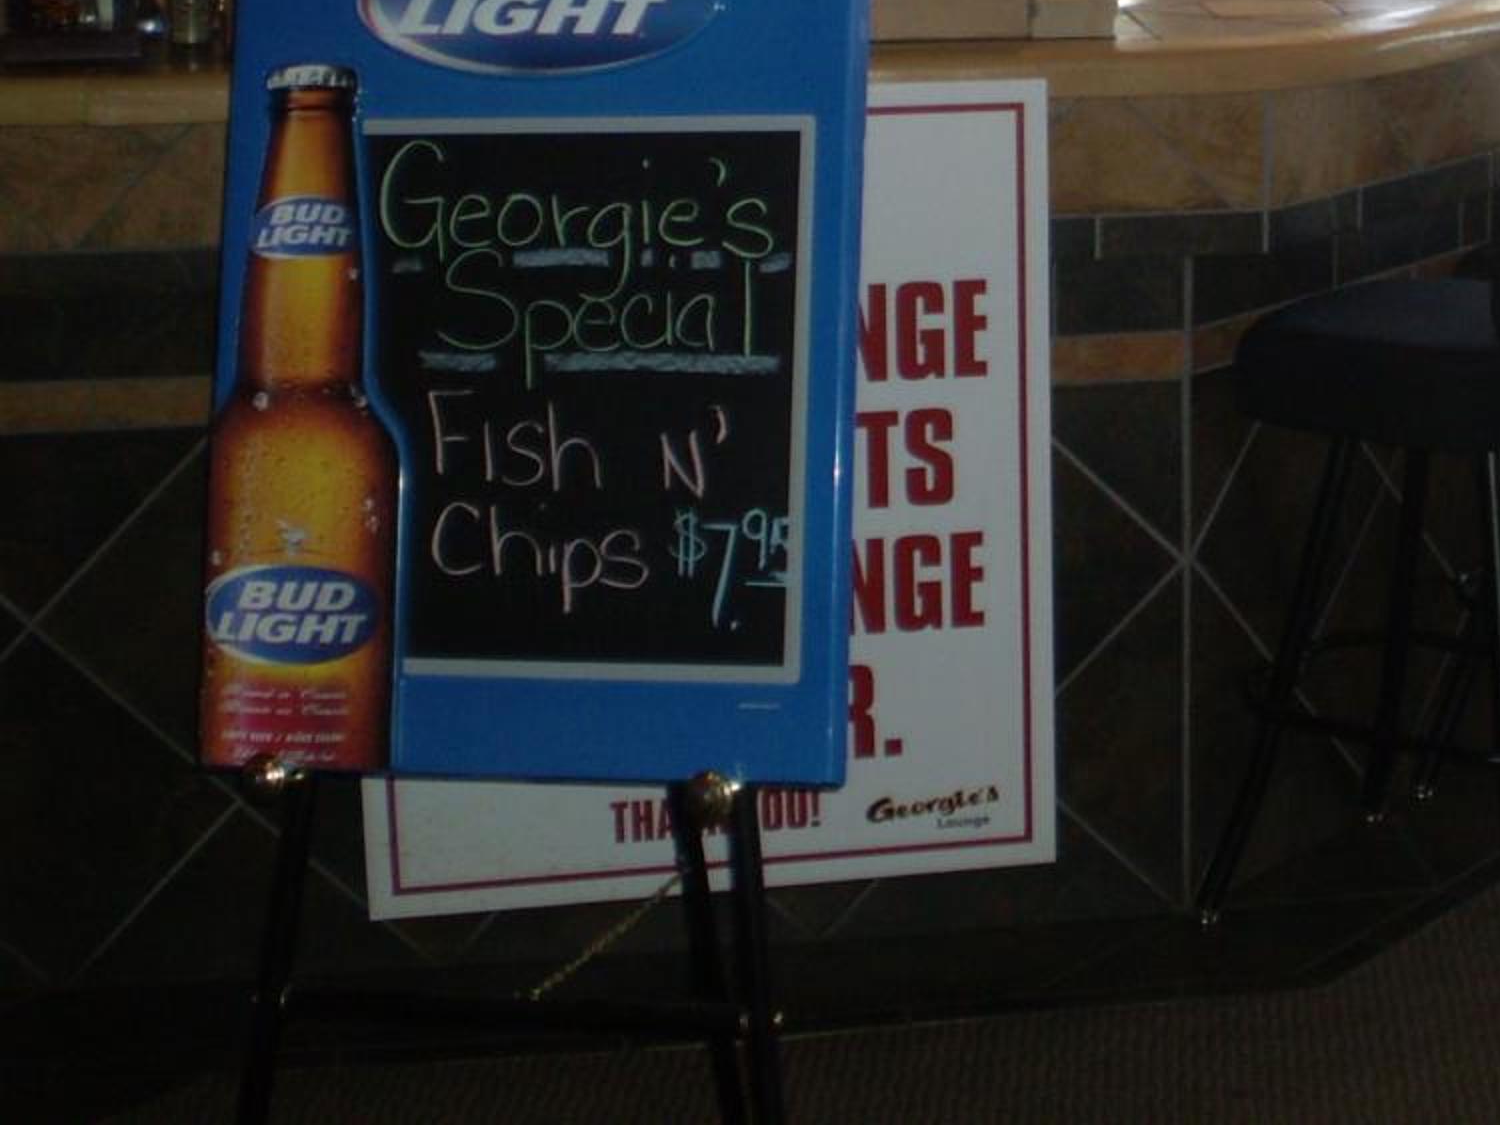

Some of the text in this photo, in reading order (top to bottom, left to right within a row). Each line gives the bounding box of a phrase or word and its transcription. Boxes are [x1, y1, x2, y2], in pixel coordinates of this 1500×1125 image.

[257, 225, 354, 249] LIGHT
[269, 203, 347, 225] BUD
[379, 139, 777, 295] Georgie's
[437, 248, 754, 389] Special
[855, 278, 989, 383] NGE
[427, 389, 602, 492] Fish
[855, 407, 954, 508] TS
[237, 581, 356, 612] BUD
[431, 501, 650, 614] Chips
[848, 530, 986, 635] NGE
[213, 613, 368, 645] LIGHT
[845, 663, 904, 758] R.
[758, 787, 821, 831] OU!
[866, 785, 999, 824] Georgie's
